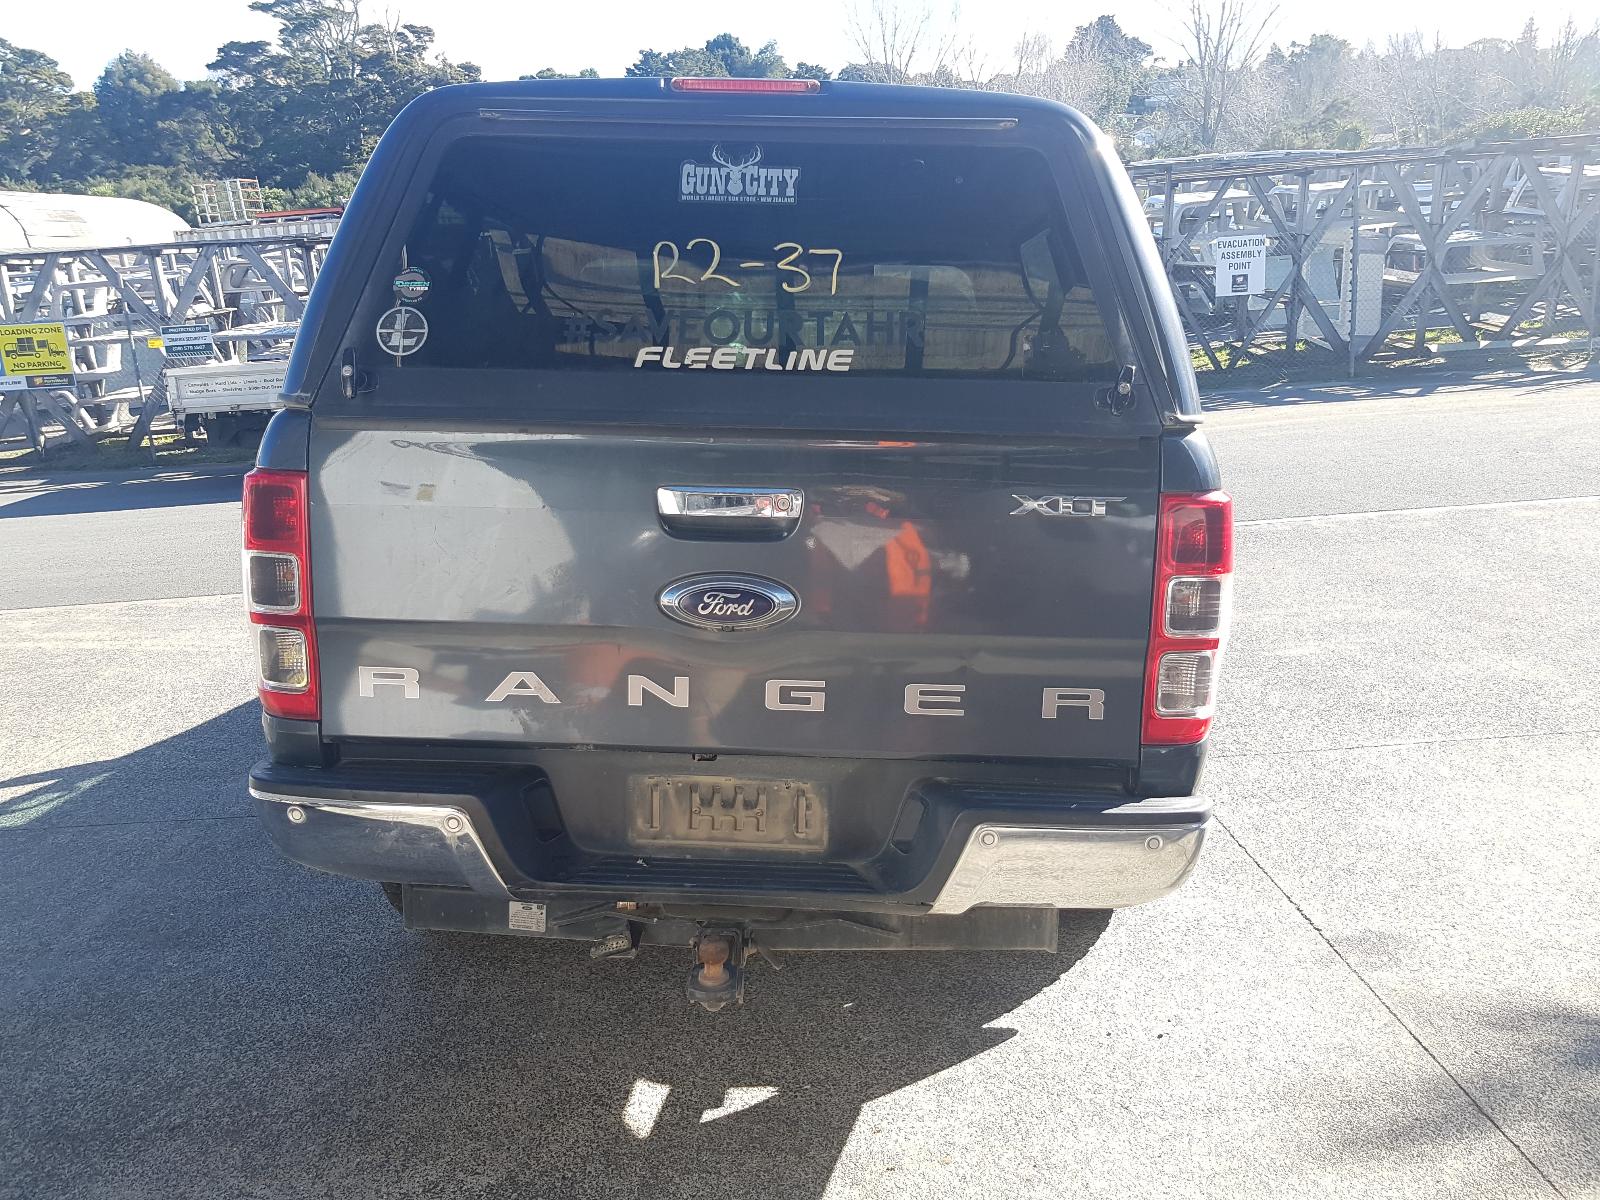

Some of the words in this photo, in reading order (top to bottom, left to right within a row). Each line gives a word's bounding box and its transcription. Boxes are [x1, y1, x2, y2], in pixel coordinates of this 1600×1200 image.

[681, 163, 731, 195] GUN
[742, 165, 799, 197] CITY
[1217, 238, 1266, 249] EVACUATION
[1220, 250, 1262, 260] ASSEMBLY
[1228, 261, 1252, 271] POINT
[0, 327, 37, 336] LOADING
[38, 326, 62, 335] ZONE
[27, 360, 62, 368] PARKING
[634, 346, 855, 372] FLEETLINE
[697, 591, 755, 617] Ford
[358, 665, 1105, 720] RANGER
